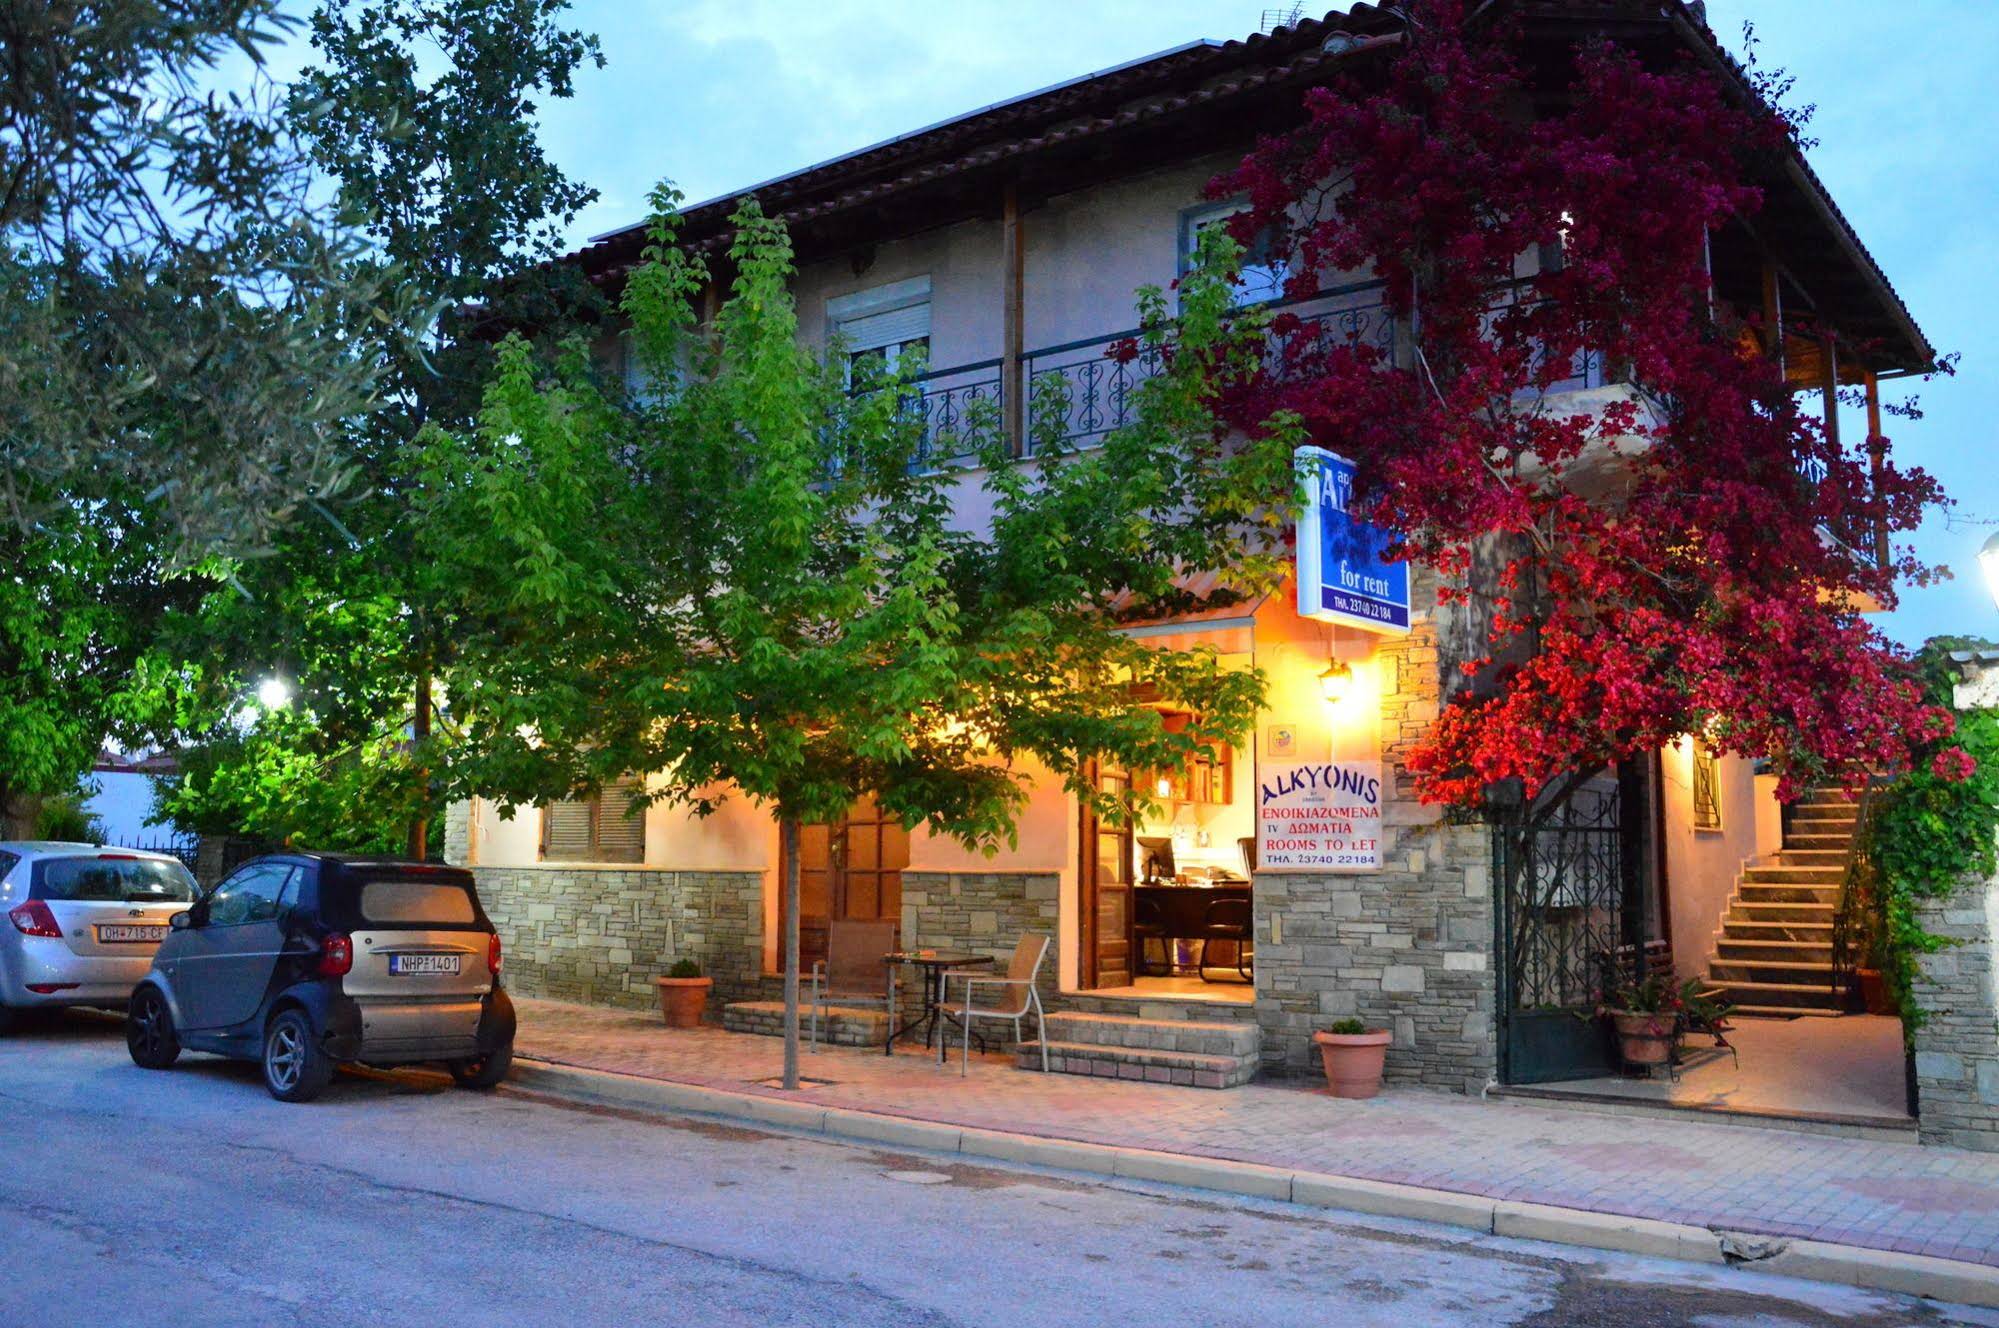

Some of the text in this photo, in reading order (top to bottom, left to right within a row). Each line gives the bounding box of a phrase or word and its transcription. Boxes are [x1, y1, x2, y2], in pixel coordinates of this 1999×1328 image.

[1341, 560, 1389, 597] for rent
[1262, 765, 1379, 804] ALKYONIS
[1262, 807, 1379, 819] ΕΝΟΙΚΙΑΖΟΜΕΝΑ
[1288, 823, 1352, 834] ΔΩΜΑΤΙΑ
[1266, 840, 1377, 850] ROOMS TO LET
[1298, 854, 1333, 863] 23740
